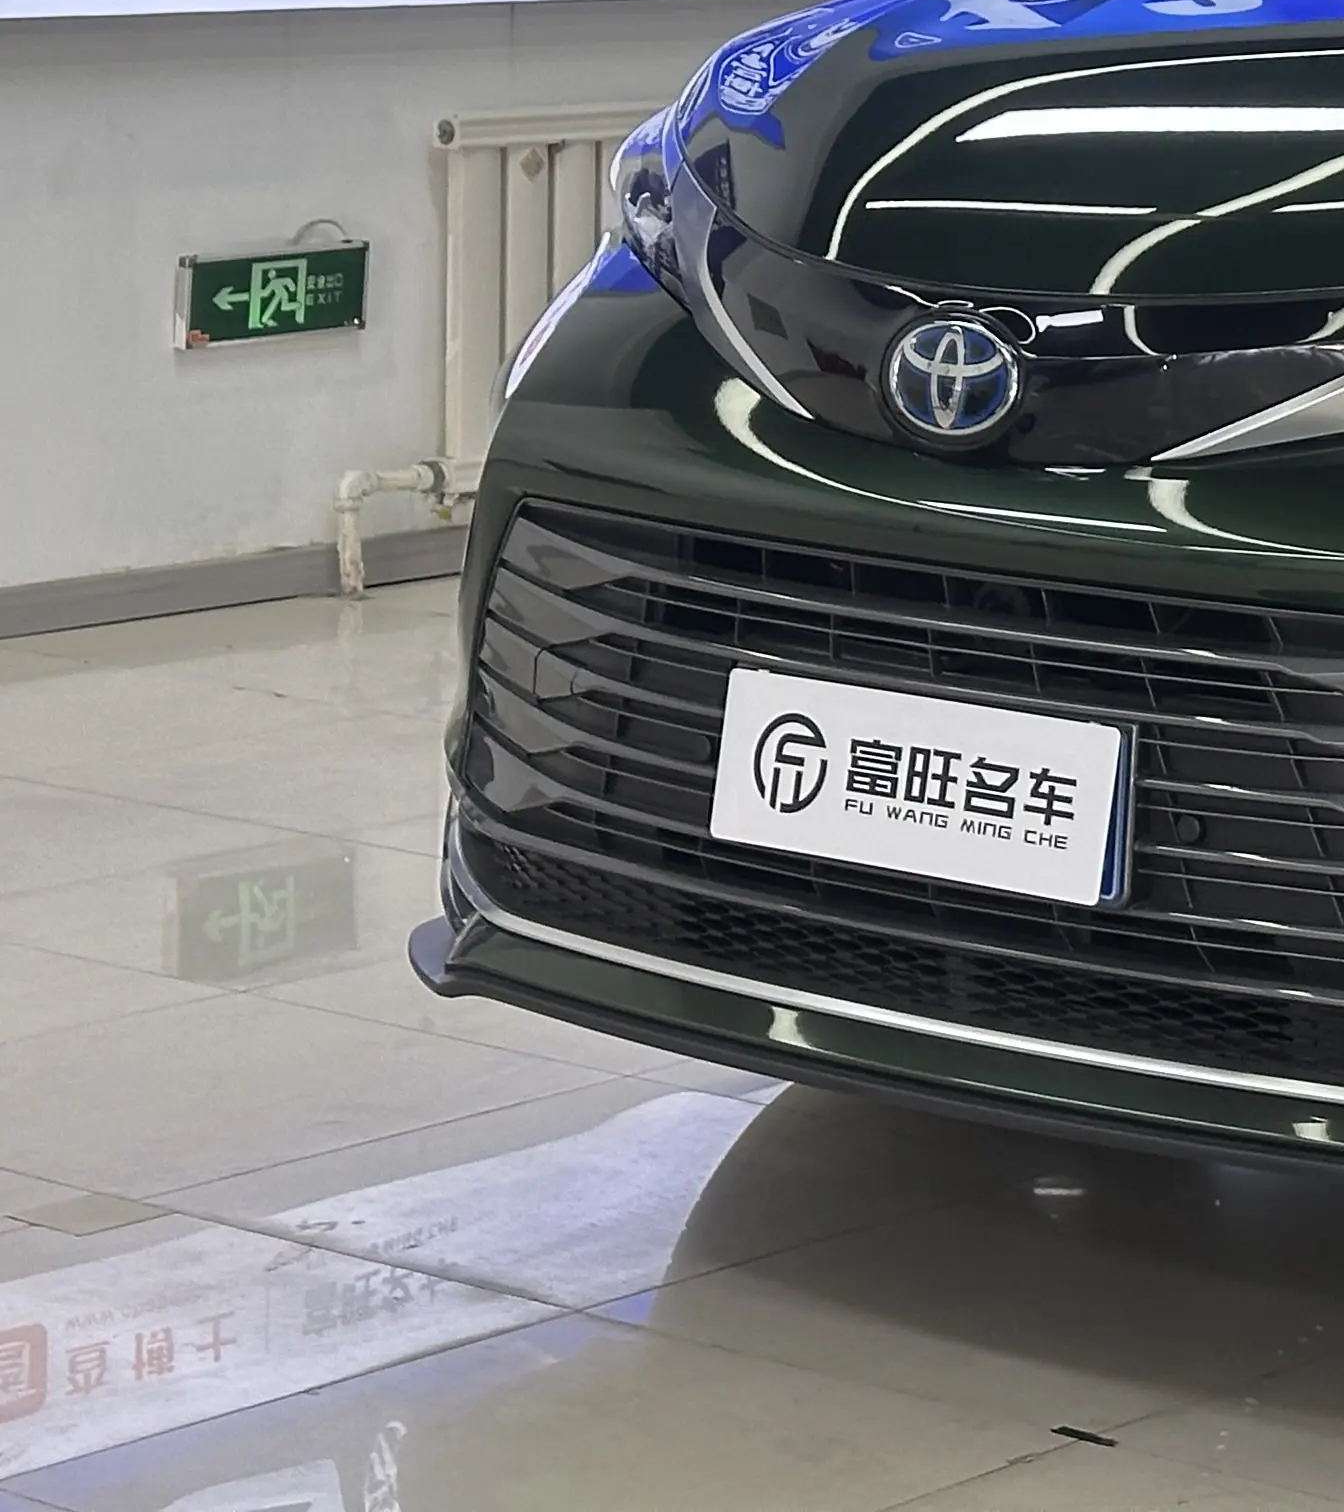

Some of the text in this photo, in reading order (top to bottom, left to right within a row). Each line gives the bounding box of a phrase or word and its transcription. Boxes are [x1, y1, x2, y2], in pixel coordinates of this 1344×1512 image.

[845, 736, 1078, 827] 富旺名车
[844, 798, 1069, 851] FU WANG MING CHE
